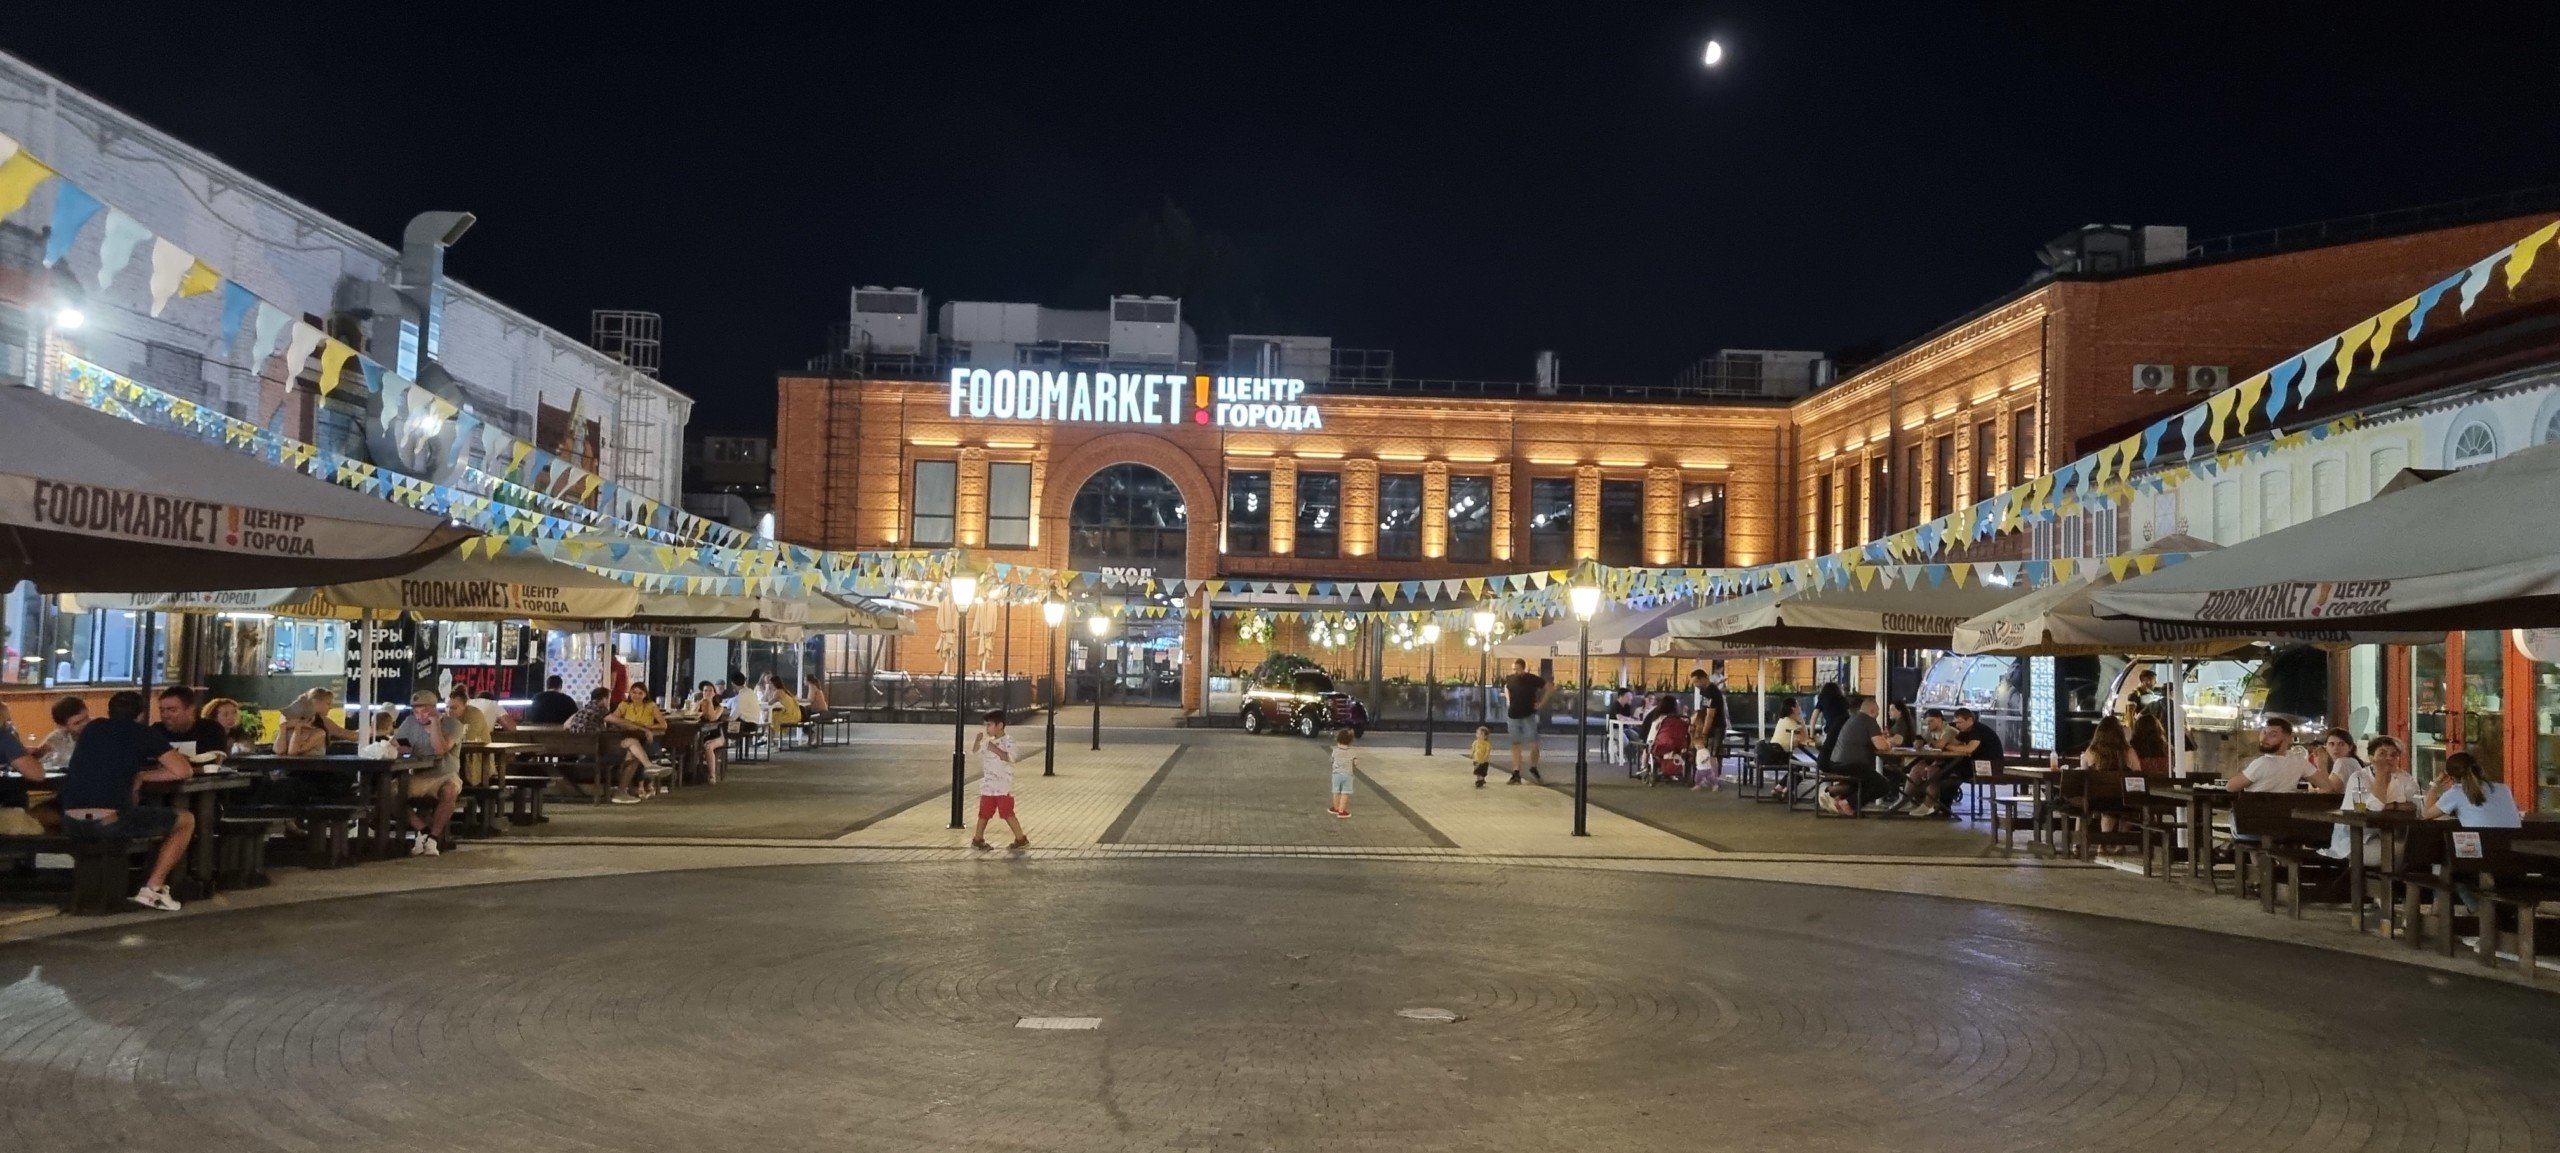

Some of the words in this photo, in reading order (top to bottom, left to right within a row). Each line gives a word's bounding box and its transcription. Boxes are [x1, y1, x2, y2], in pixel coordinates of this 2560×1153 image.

[949, 367, 1188, 425] FOODMARKET
[1217, 376, 1306, 403] ЦЕНТР
[1216, 403, 1324, 431] ГОРОДА
[34, 480, 223, 545] FOODMARKET
[244, 508, 305, 533] ЦЕНТР
[243, 532, 316, 556] ГОРОДА
[400, 579, 508, 608] FOODMARKET
[522, 585, 560, 599] ЦЕНТР
[2194, 583, 2318, 621] FOODMARKET
[2333, 580, 2391, 599] ЦЕНТР
[523, 599, 570, 614] ГОРОДА
[2325, 599, 2389, 617] ГОРОДА
